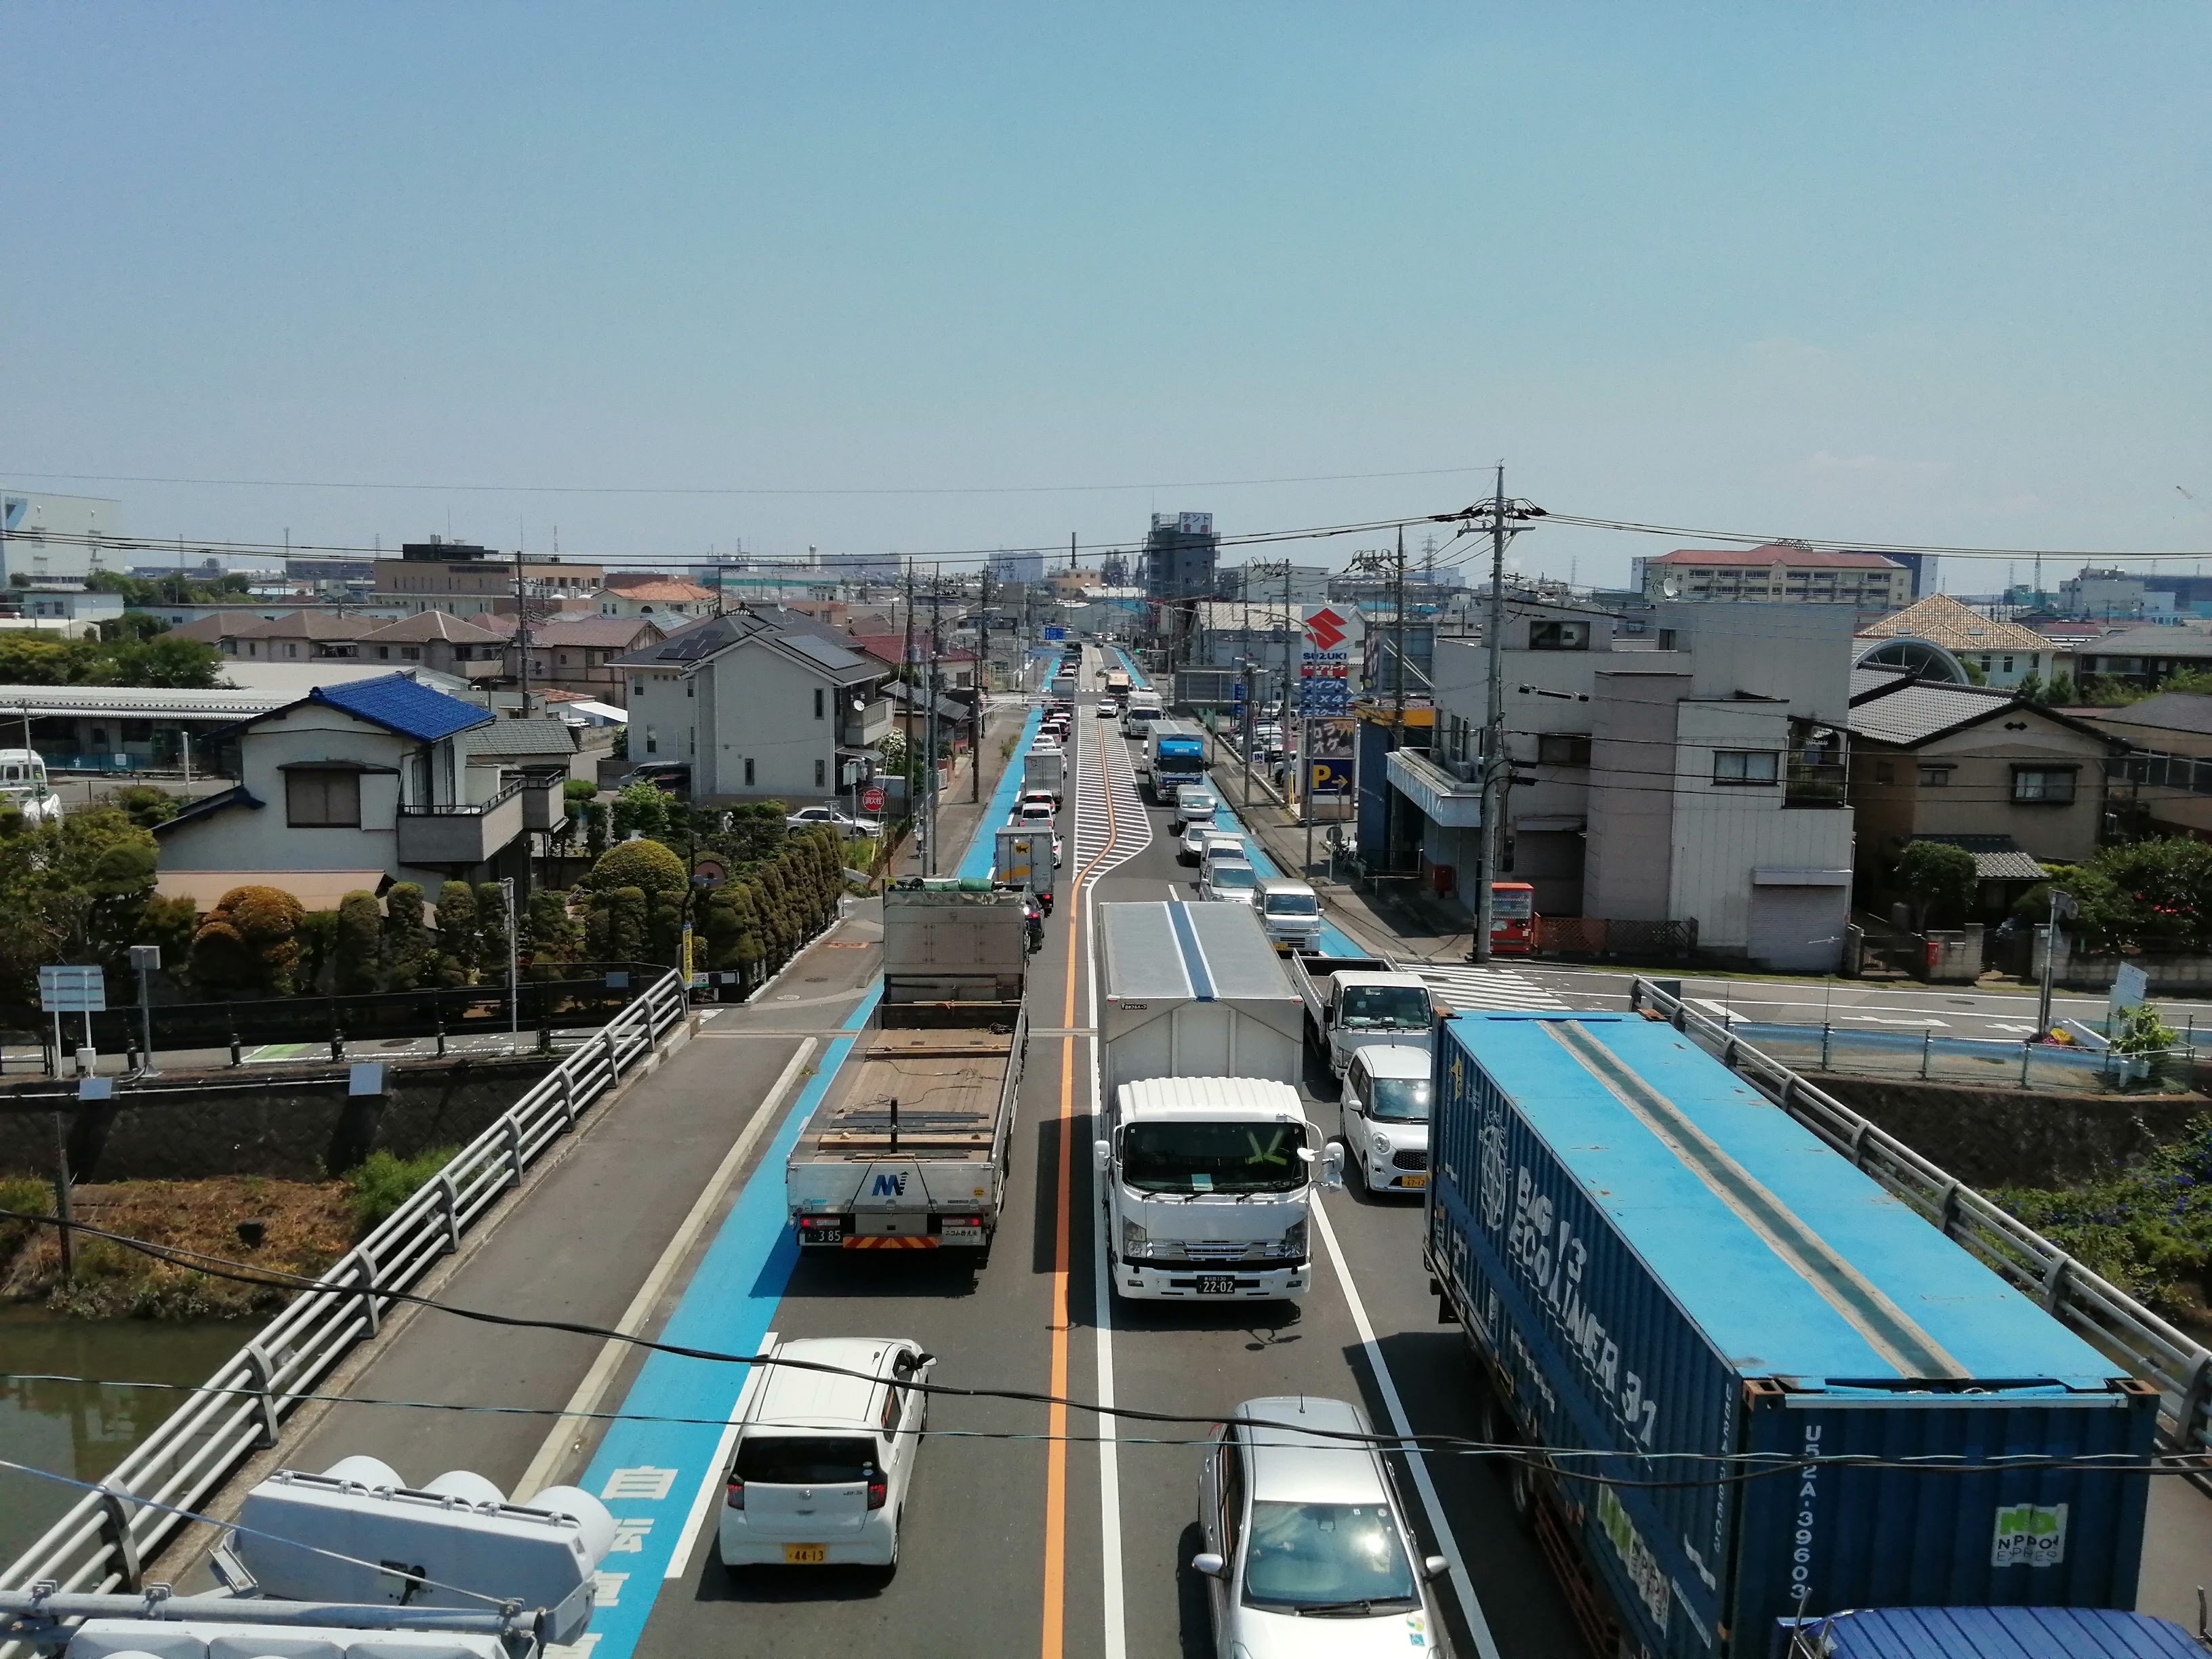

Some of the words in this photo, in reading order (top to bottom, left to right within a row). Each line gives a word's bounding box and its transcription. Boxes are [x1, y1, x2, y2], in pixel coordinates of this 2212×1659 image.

[1183, 514, 1209, 524] テント
[1304, 680, 1345, 689] スイフト
[1313, 764, 1332, 789] P
[1517, 1165, 1553, 1236] BIG
[1790, 1425, 1822, 1600] U52A-39603
